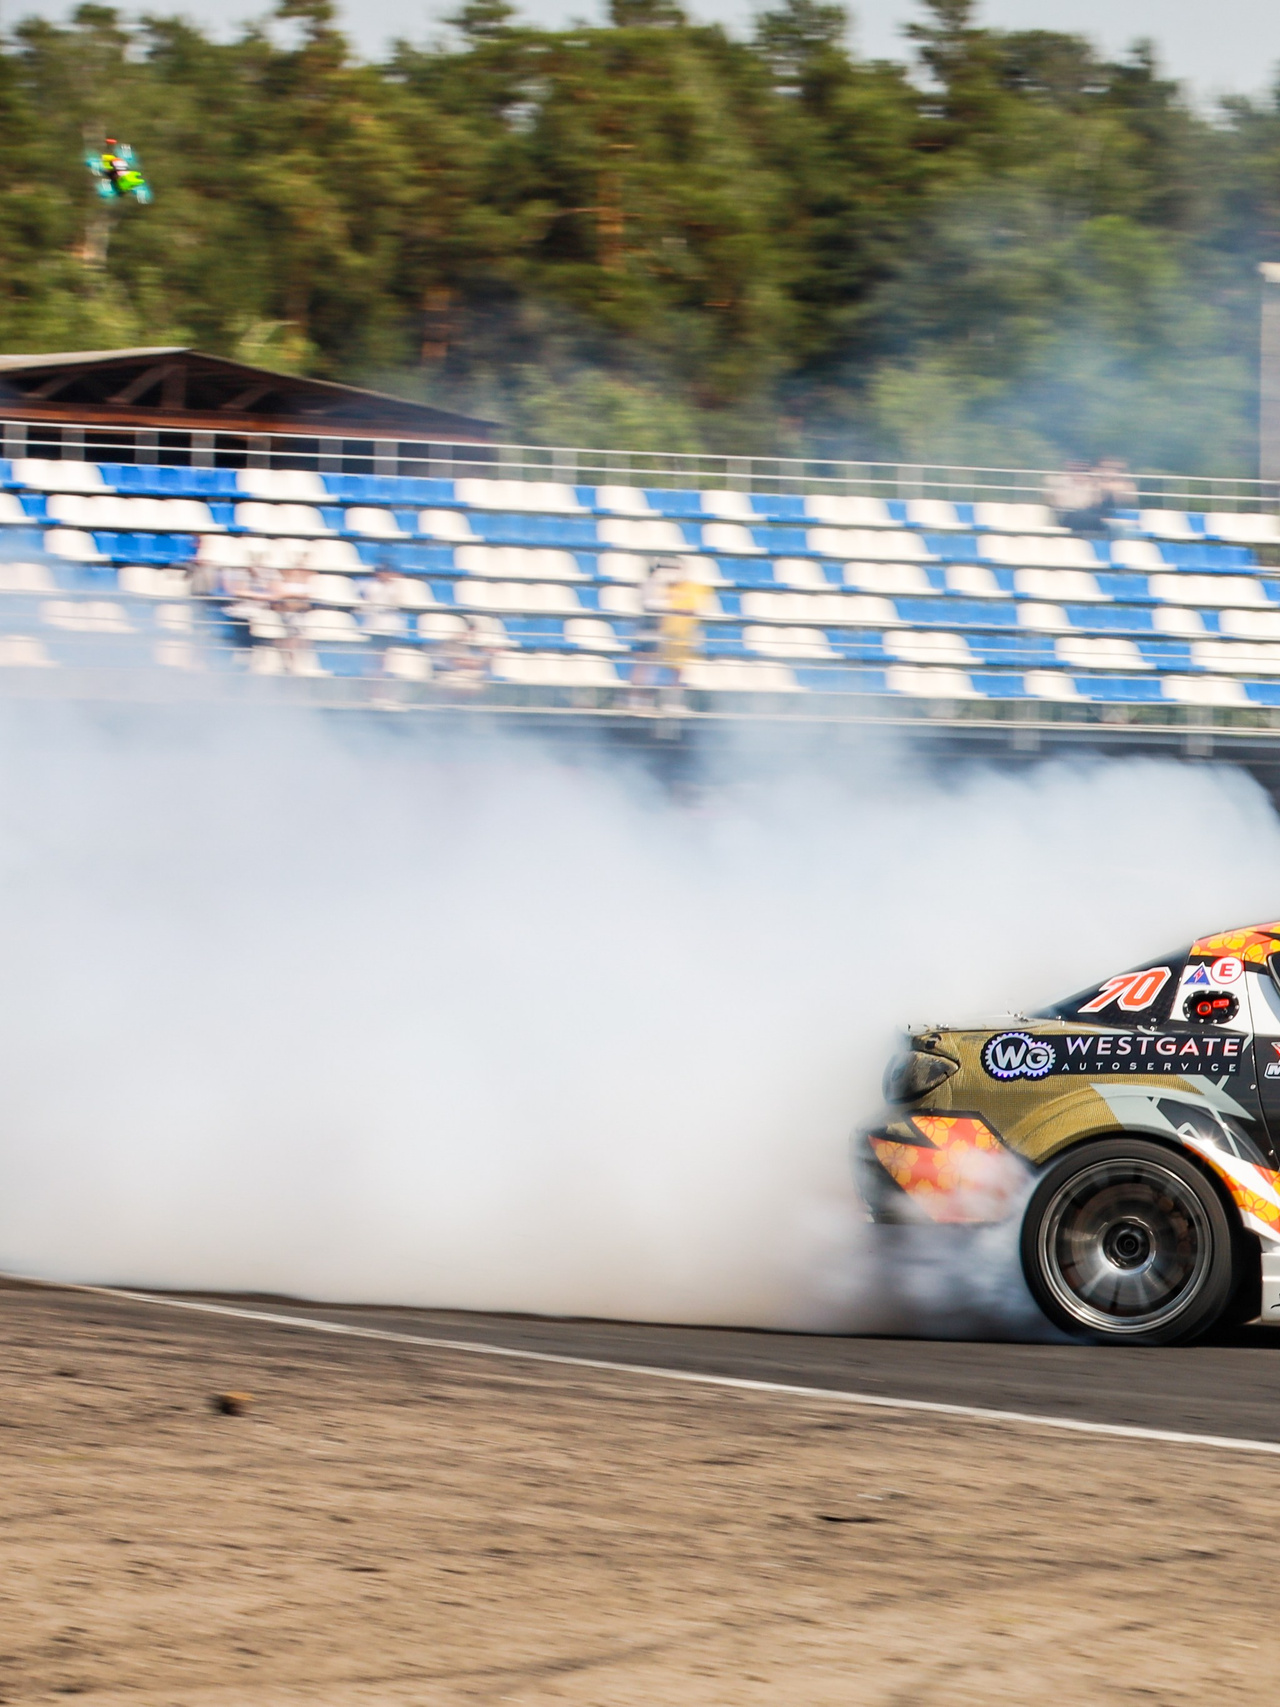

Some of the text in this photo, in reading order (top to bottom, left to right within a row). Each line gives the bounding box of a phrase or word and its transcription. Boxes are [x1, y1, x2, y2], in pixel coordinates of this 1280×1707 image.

[1219, 963, 1235, 977] E
[1077, 966, 1172, 1014] 70
[994, 1042, 1049, 1071] WG
[1066, 1036, 1240, 1057] WESTGATE
[1061, 1062, 1236, 1073] AUTOSERVICE
